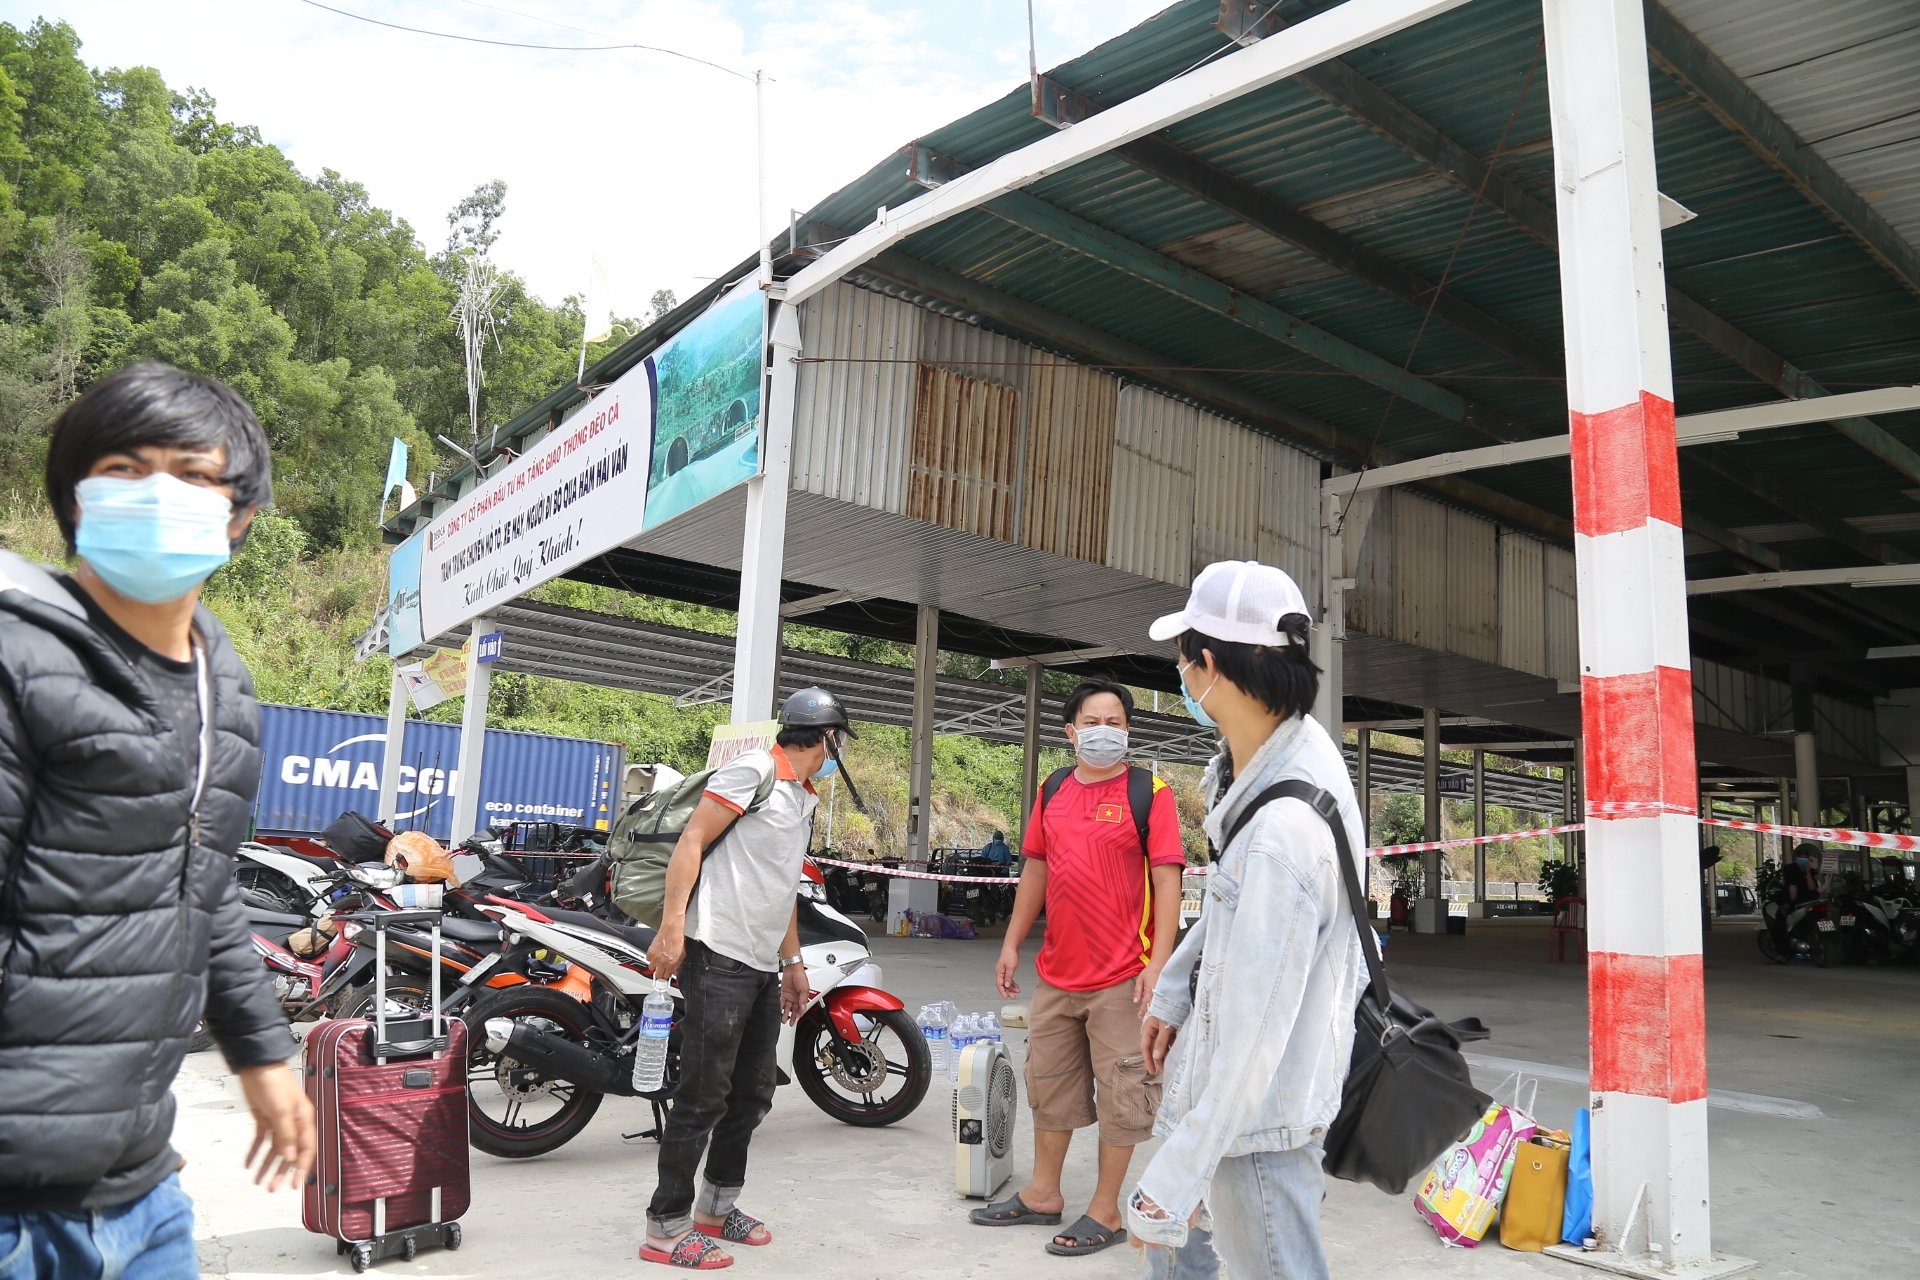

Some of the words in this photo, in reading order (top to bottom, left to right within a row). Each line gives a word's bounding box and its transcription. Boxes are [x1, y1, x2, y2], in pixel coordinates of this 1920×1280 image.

[461, 512, 467, 528] TY
[545, 445, 561, 471] GIAO
[563, 425, 588, 458] THÔNG
[589, 411, 606, 440] ĐÈO
[608, 394, 619, 426] CẢ
[503, 520, 511, 546] XE
[563, 476, 577, 509] QUA
[578, 455, 595, 499] HẦM
[596, 447, 611, 488] HẢI
[611, 437, 628, 478] VÂN
[486, 567, 510, 595] Chào
[512, 549, 534, 584] Quý
[535, 524, 573, 570] Khách
[280, 755, 379, 791] CMA
[397, 765, 458, 797] CG
[485, 801, 512, 813] eco
[515, 803, 584, 818] container
